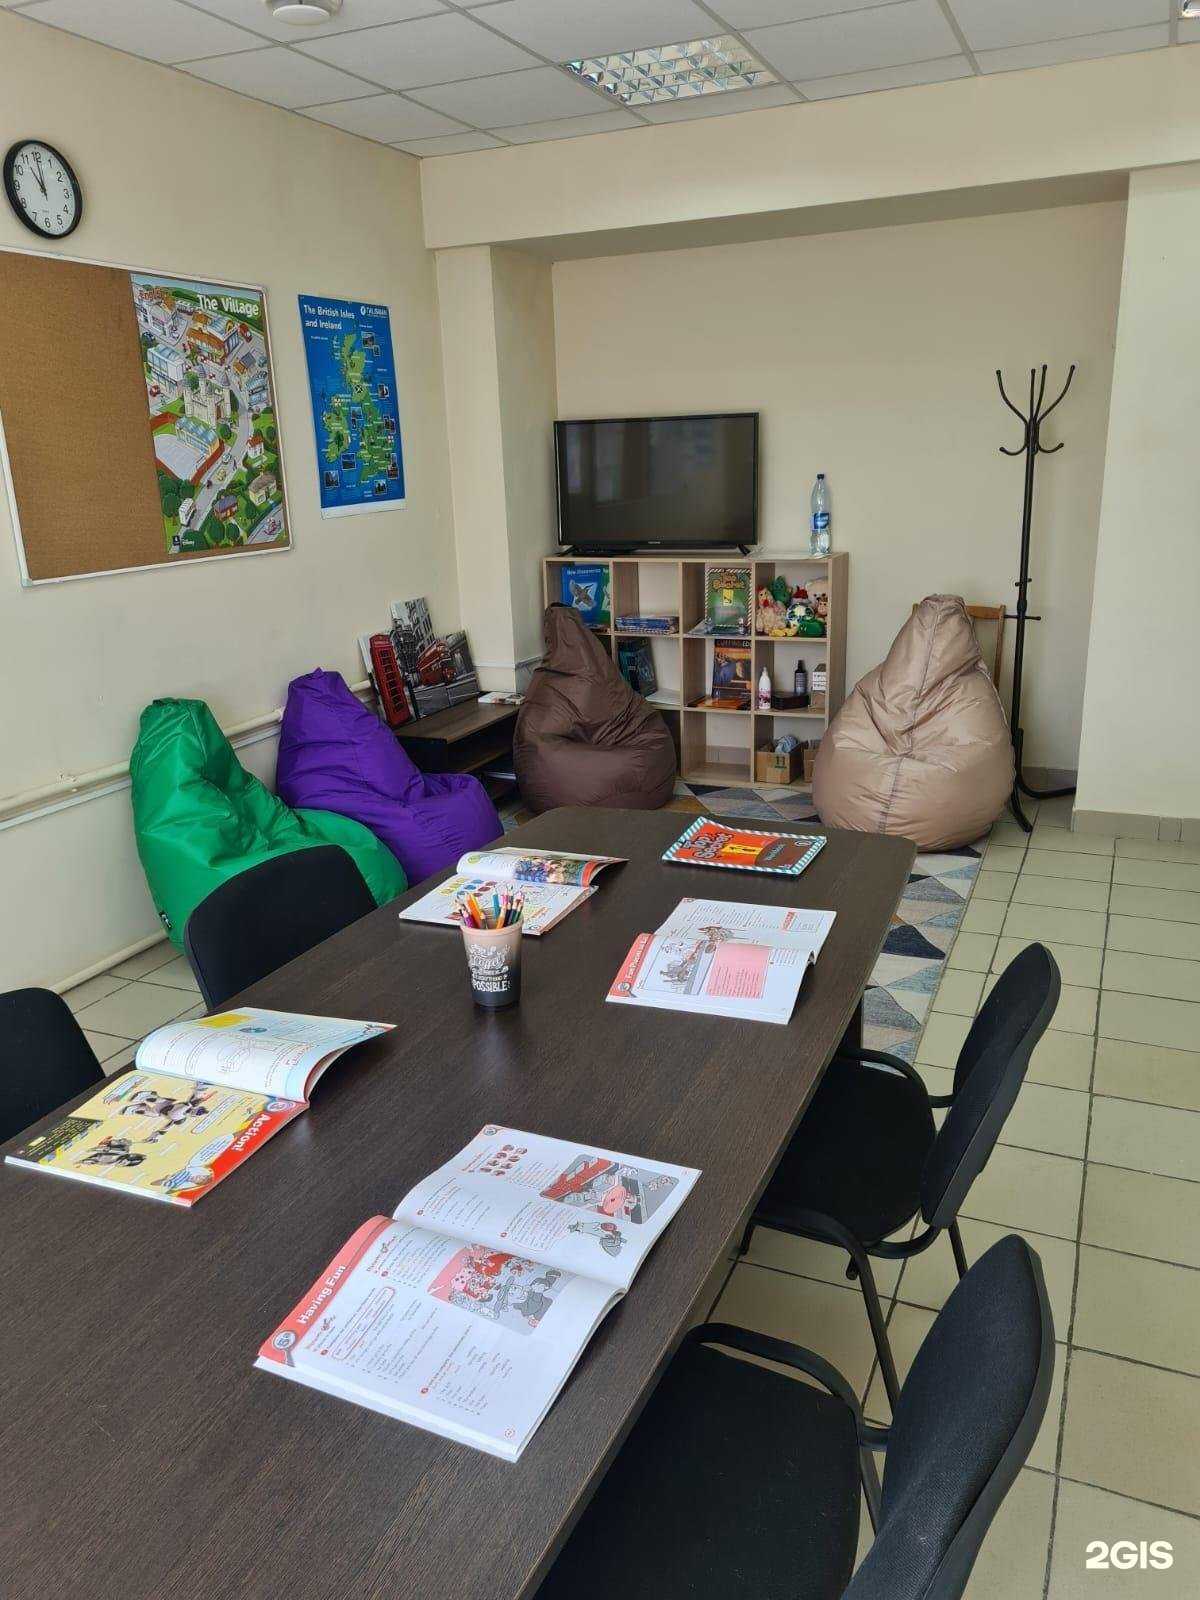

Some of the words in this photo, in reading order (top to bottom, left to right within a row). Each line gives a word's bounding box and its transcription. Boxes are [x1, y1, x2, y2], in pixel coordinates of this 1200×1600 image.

[15, 164, 24, 176] 10
[57, 171, 63, 182] 2
[63, 188, 69, 199] 3
[21, 197, 27, 209] 8
[63, 204, 69, 214] 4
[32, 211, 38, 221] 7
[57, 214, 63, 225] 5
[44, 217, 51, 228] 6
[197, 294, 218, 311] The
[222, 296, 260, 317] Village
[303, 305, 316, 315] The
[317, 307, 339, 318] British
[340, 310, 355, 320] Isles
[305, 319, 318, 328] and
[319, 319, 342, 330] Ireland
[296, 1287, 333, 1325] Having
[326, 1264, 347, 1287] Fun
